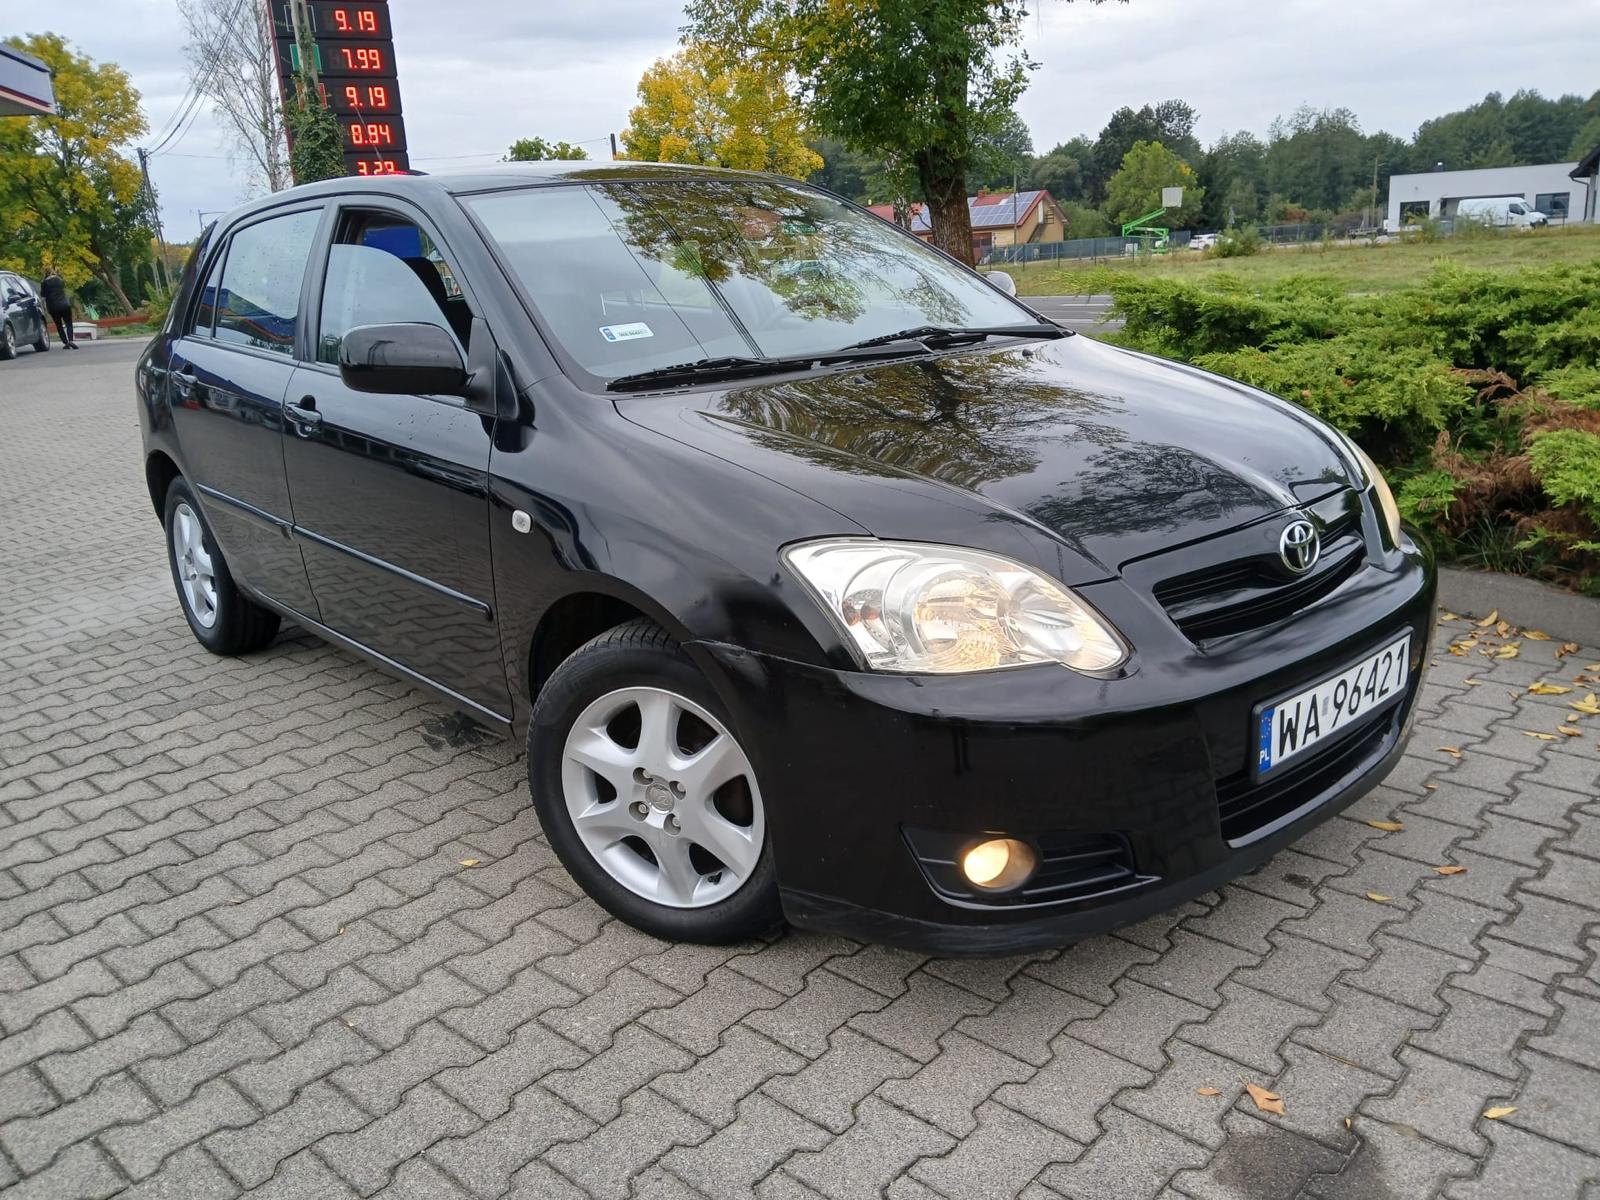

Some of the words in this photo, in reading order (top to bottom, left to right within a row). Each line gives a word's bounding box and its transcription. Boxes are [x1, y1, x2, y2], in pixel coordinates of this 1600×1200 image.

[335, 10, 376, 31] 9.19
[341, 49, 381, 69] 7.99
[345, 87, 387, 107] 9.19
[1279, 693, 1320, 758] WA
[1331, 642, 1406, 729] 96421
[1259, 748, 1270, 765] PL
